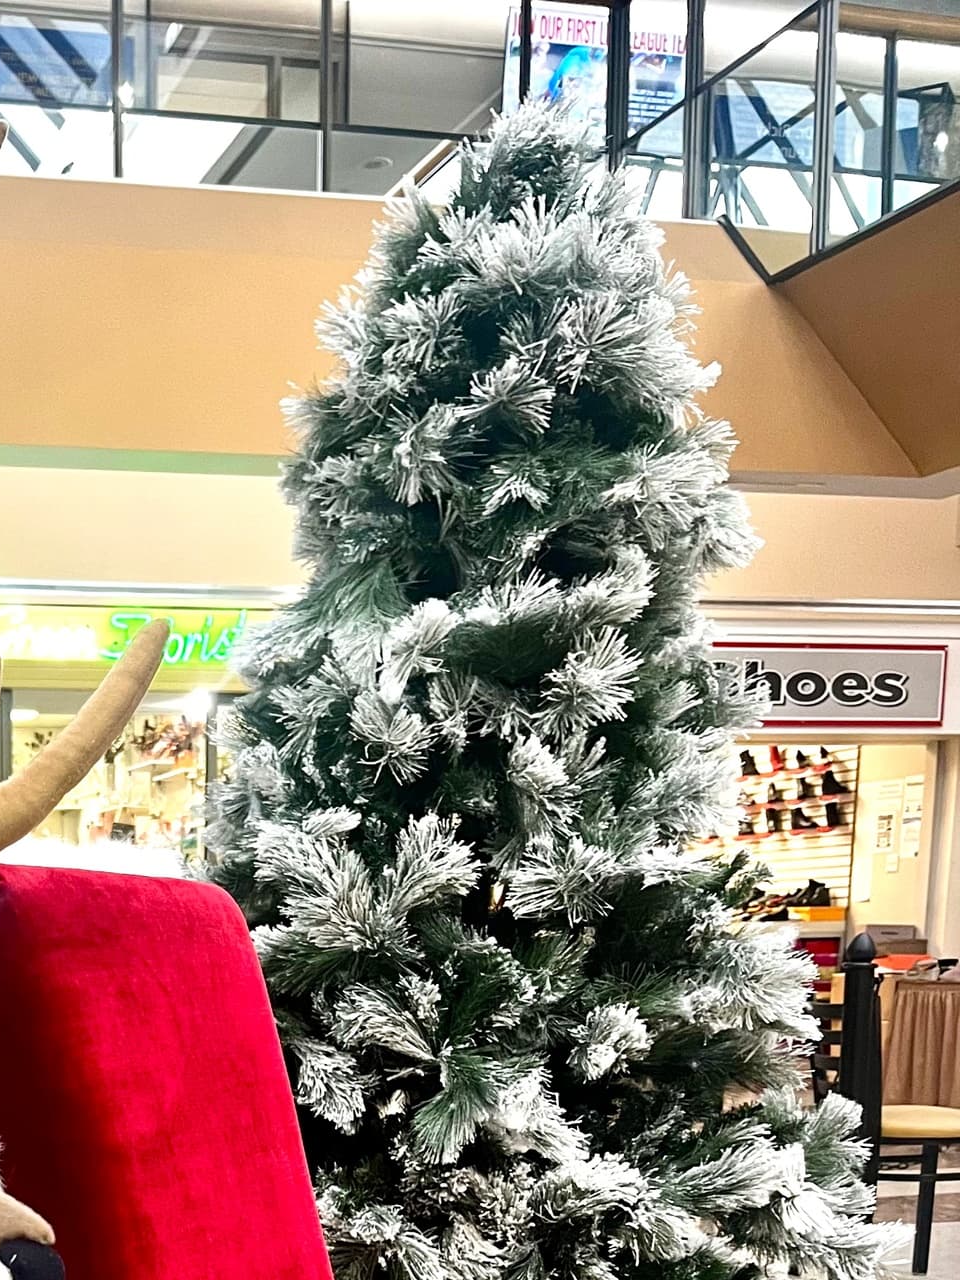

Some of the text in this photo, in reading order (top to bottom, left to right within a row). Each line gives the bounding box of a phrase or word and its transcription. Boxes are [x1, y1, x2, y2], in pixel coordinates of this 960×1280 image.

[540, 15, 563, 40] OUR
[568, 18, 596, 44] FIRST
[631, 32, 668, 53] EAGUE
[99, 609, 247, 664] Forist
